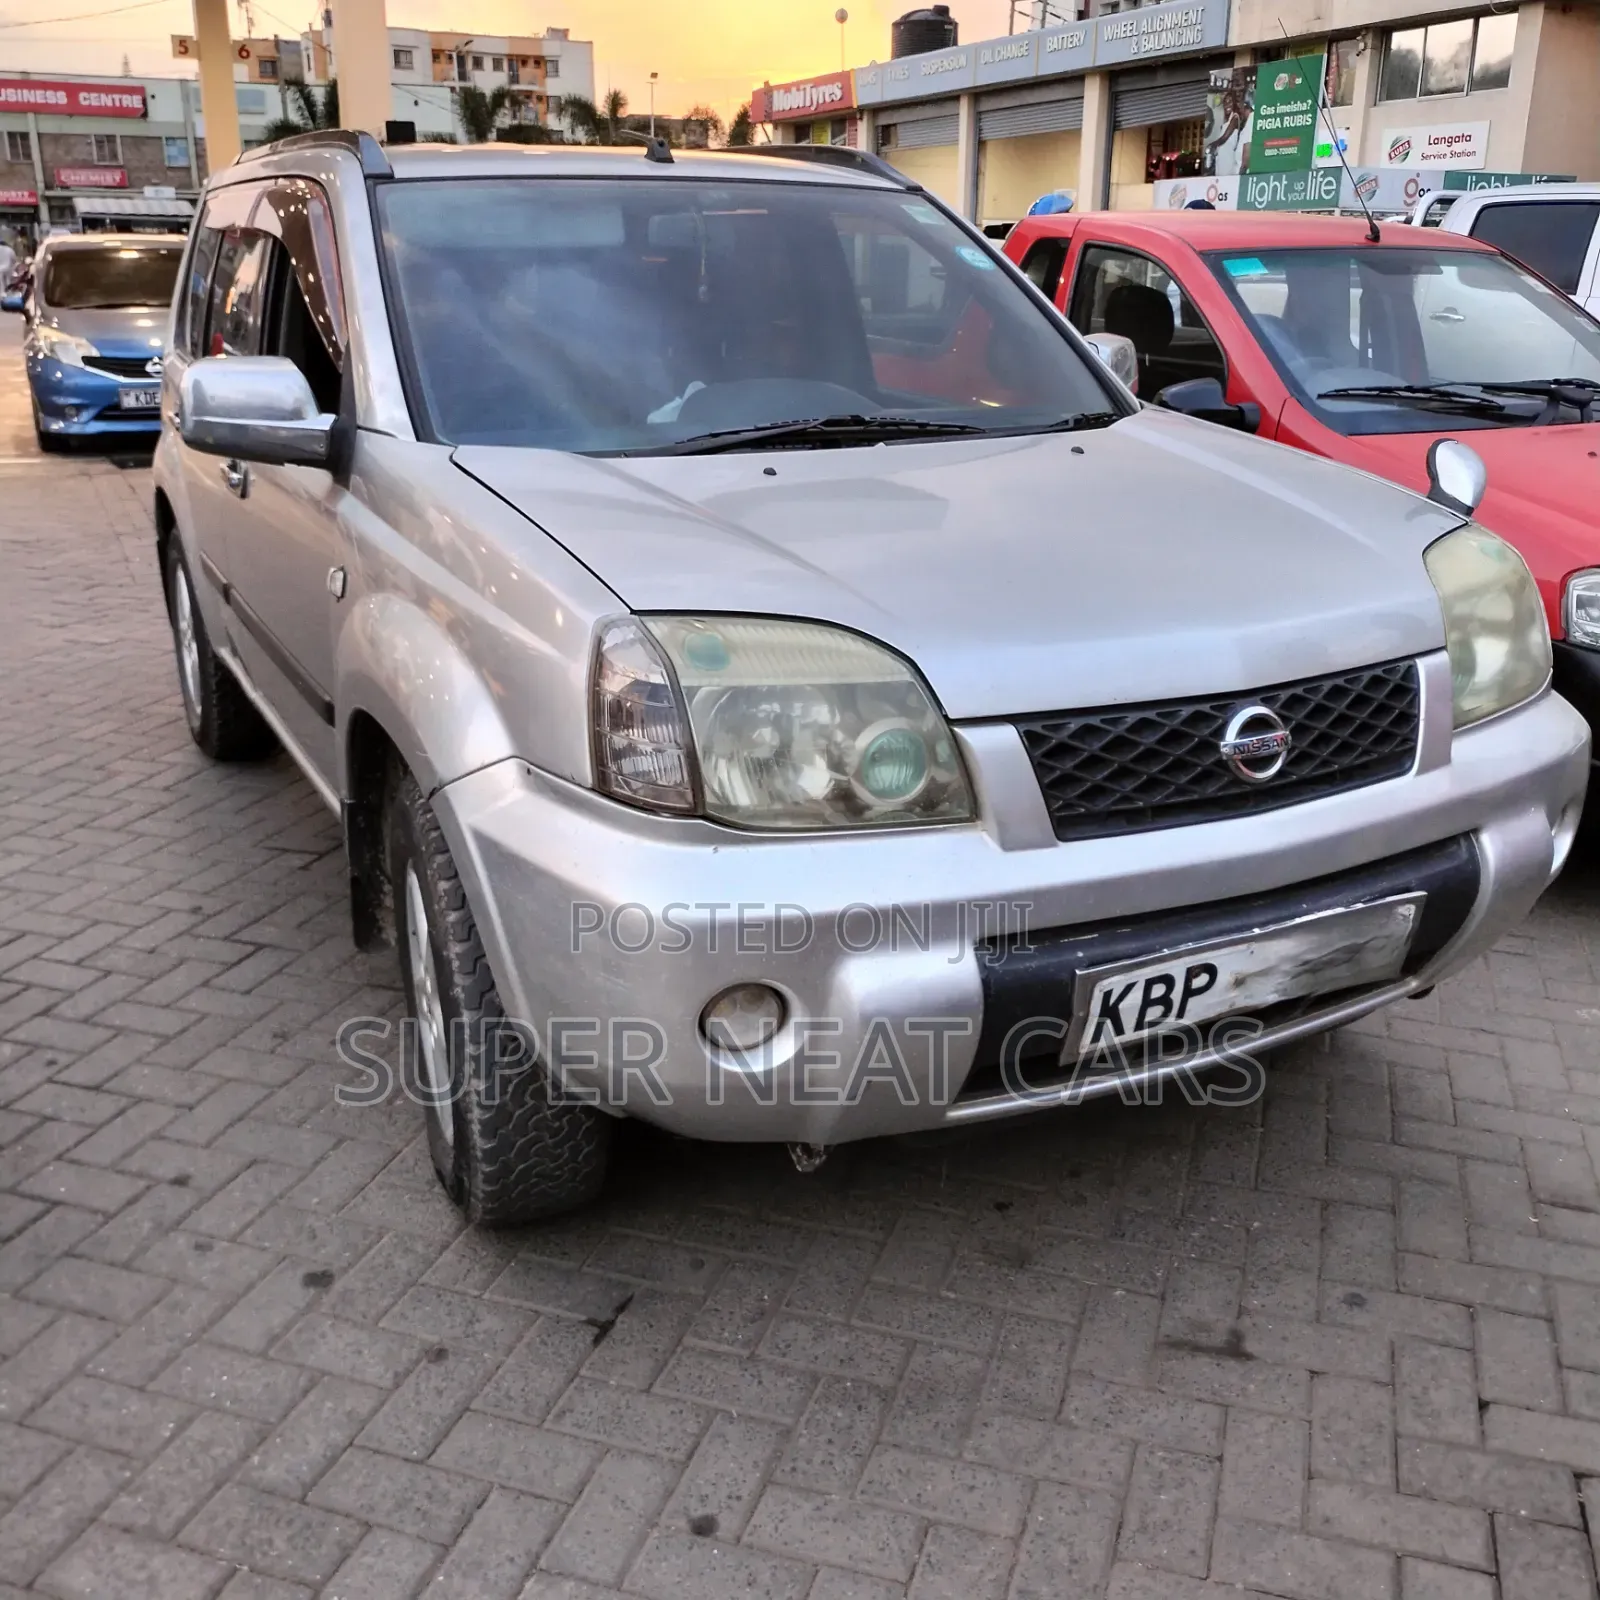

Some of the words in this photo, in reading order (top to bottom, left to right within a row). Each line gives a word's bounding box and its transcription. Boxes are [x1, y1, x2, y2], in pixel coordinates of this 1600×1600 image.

[1103, 20, 1139, 41] WHEEL
[1141, 6, 1204, 35] ALIGNMENT
[178, 40, 189, 55] 5
[1046, 29, 1087, 53] BATTERY
[1130, 36, 1139, 54] &
[1142, 26, 1203, 53] BALANCING
[238, 44, 250, 59] 6
[995, 40, 1030, 62] CHANGE
[920, 53, 967, 76] SUSPENSION
[78, 92, 144, 108] CENTRE
[1260, 104, 1275, 116] Gas
[1276, 100, 1312, 116] imeisha?
[1256, 117, 1282, 131] PIGIA
[1283, 114, 1313, 128] RUBIS
[1389, 140, 1410, 160] RUBIS
[1428, 133, 1472, 148] Langata
[1421, 151, 1448, 161] Service
[1449, 149, 1476, 159] Station
[1246, 174, 1288, 208] light
[1293, 181, 1305, 192] up
[1306, 170, 1337, 200] life
[1287, 192, 1306, 203] your
[1233, 735, 1288, 755] NISSAN
[1089, 961, 1219, 1046] KBP
